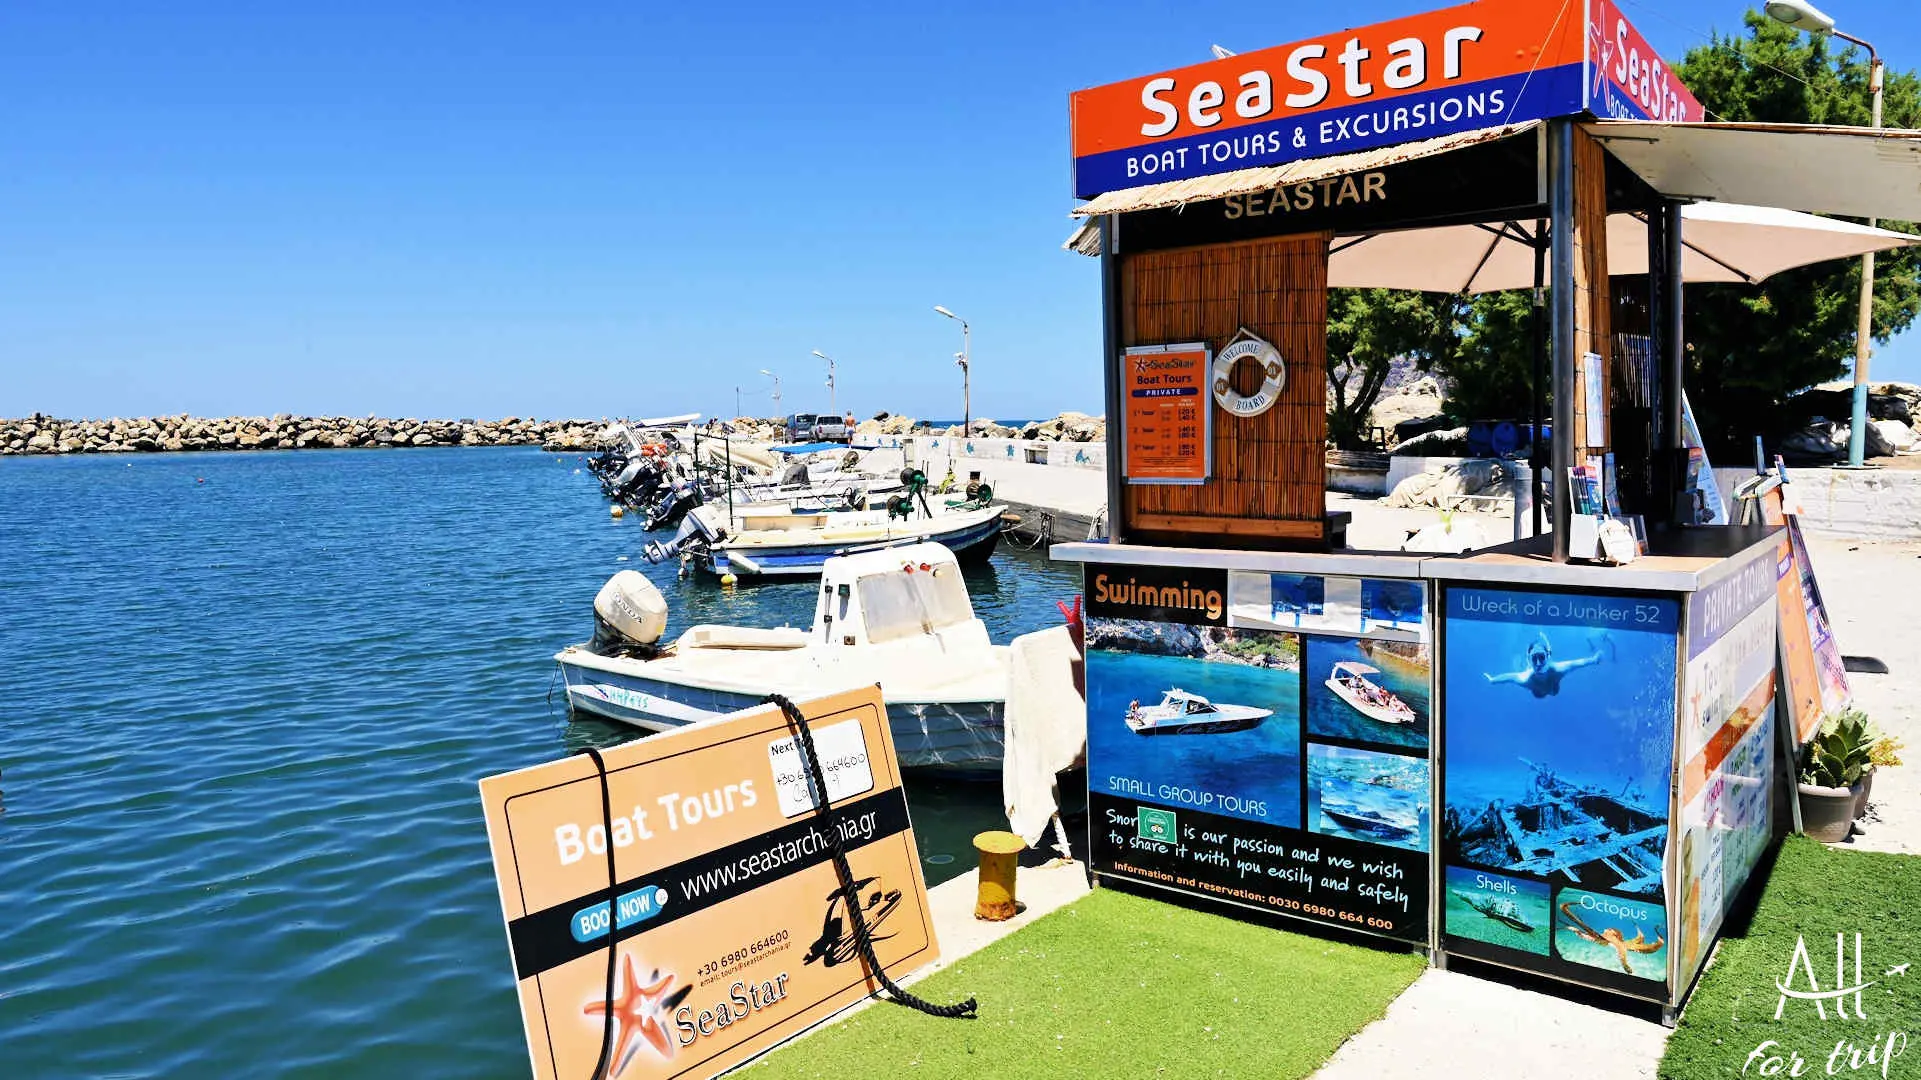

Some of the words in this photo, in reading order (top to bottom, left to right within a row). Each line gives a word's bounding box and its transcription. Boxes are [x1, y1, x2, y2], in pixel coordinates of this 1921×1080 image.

[1140, 26, 1483, 137] SeaStar
[1616, 18, 1686, 121] SeaStar
[1127, 148, 1189, 177] BOAT
[1198, 131, 1281, 164] TOURS
[1292, 127, 1307, 148] &
[1320, 89, 1505, 144] EXCURSIONS
[1224, 172, 1386, 219] SEASTAR
[1223, 343, 1260, 361] WELCOME
[1137, 376, 1160, 384] Boat
[1163, 374, 1192, 383] Tours
[1146, 388, 1181, 396] PRIVATE
[1236, 395, 1265, 410] BOARD
[1095, 573, 1222, 620] Swimming
[1462, 595, 1518, 615] Wreck
[1524, 600, 1542, 616] of
[1548, 605, 1560, 617] a
[1565, 601, 1629, 621] Junker
[1634, 605, 1660, 624] 52
[1704, 573, 1742, 638] PRIVATE
[1745, 558, 1769, 606] TOURS
[771, 742, 795, 756] Next
[827, 753, 866, 772] 664600
[1109, 776, 1155, 797] SMALL
[1158, 784, 1213, 806] GROUP
[1216, 794, 1267, 817] TOURS
[554, 805, 654, 866] Boat
[657, 778, 758, 831] Tours
[680, 811, 877, 901] www.seastarchia.gr
[1109, 830, 1123, 844] to
[1130, 836, 1168, 854] share
[1175, 843, 1188, 858] it
[1194, 850, 1229, 868] with
[1237, 858, 1261, 879] you
[1268, 867, 1312, 892] easily
[1321, 877, 1349, 891] and
[1358, 883, 1408, 912] safely
[1184, 824, 1196, 840] is
[1201, 831, 1227, 845] our
[1233, 838, 1283, 856] passion
[1292, 848, 1319, 862] and
[1328, 856, 1355, 869] we
[1363, 861, 1403, 879] wish
[620, 893, 651, 918] NOW
[1114, 861, 1173, 881] Information
[1176, 874, 1196, 887] and
[1199, 881, 1266, 903] reservation:
[1269, 896, 1300, 910] 0030
[1303, 903, 1335, 917] 6980
[1339, 911, 1364, 924] 664
[1367, 917, 1393, 930] 600
[1476, 874, 1517, 895] Shells
[1580, 895, 1648, 922] Octopus
[697, 961, 718, 976] +30
[721, 948, 748, 967] 6980
[750, 930, 789, 954] 664600
[700, 975, 721, 987] email:
[675, 971, 789, 1046] SeaStar
